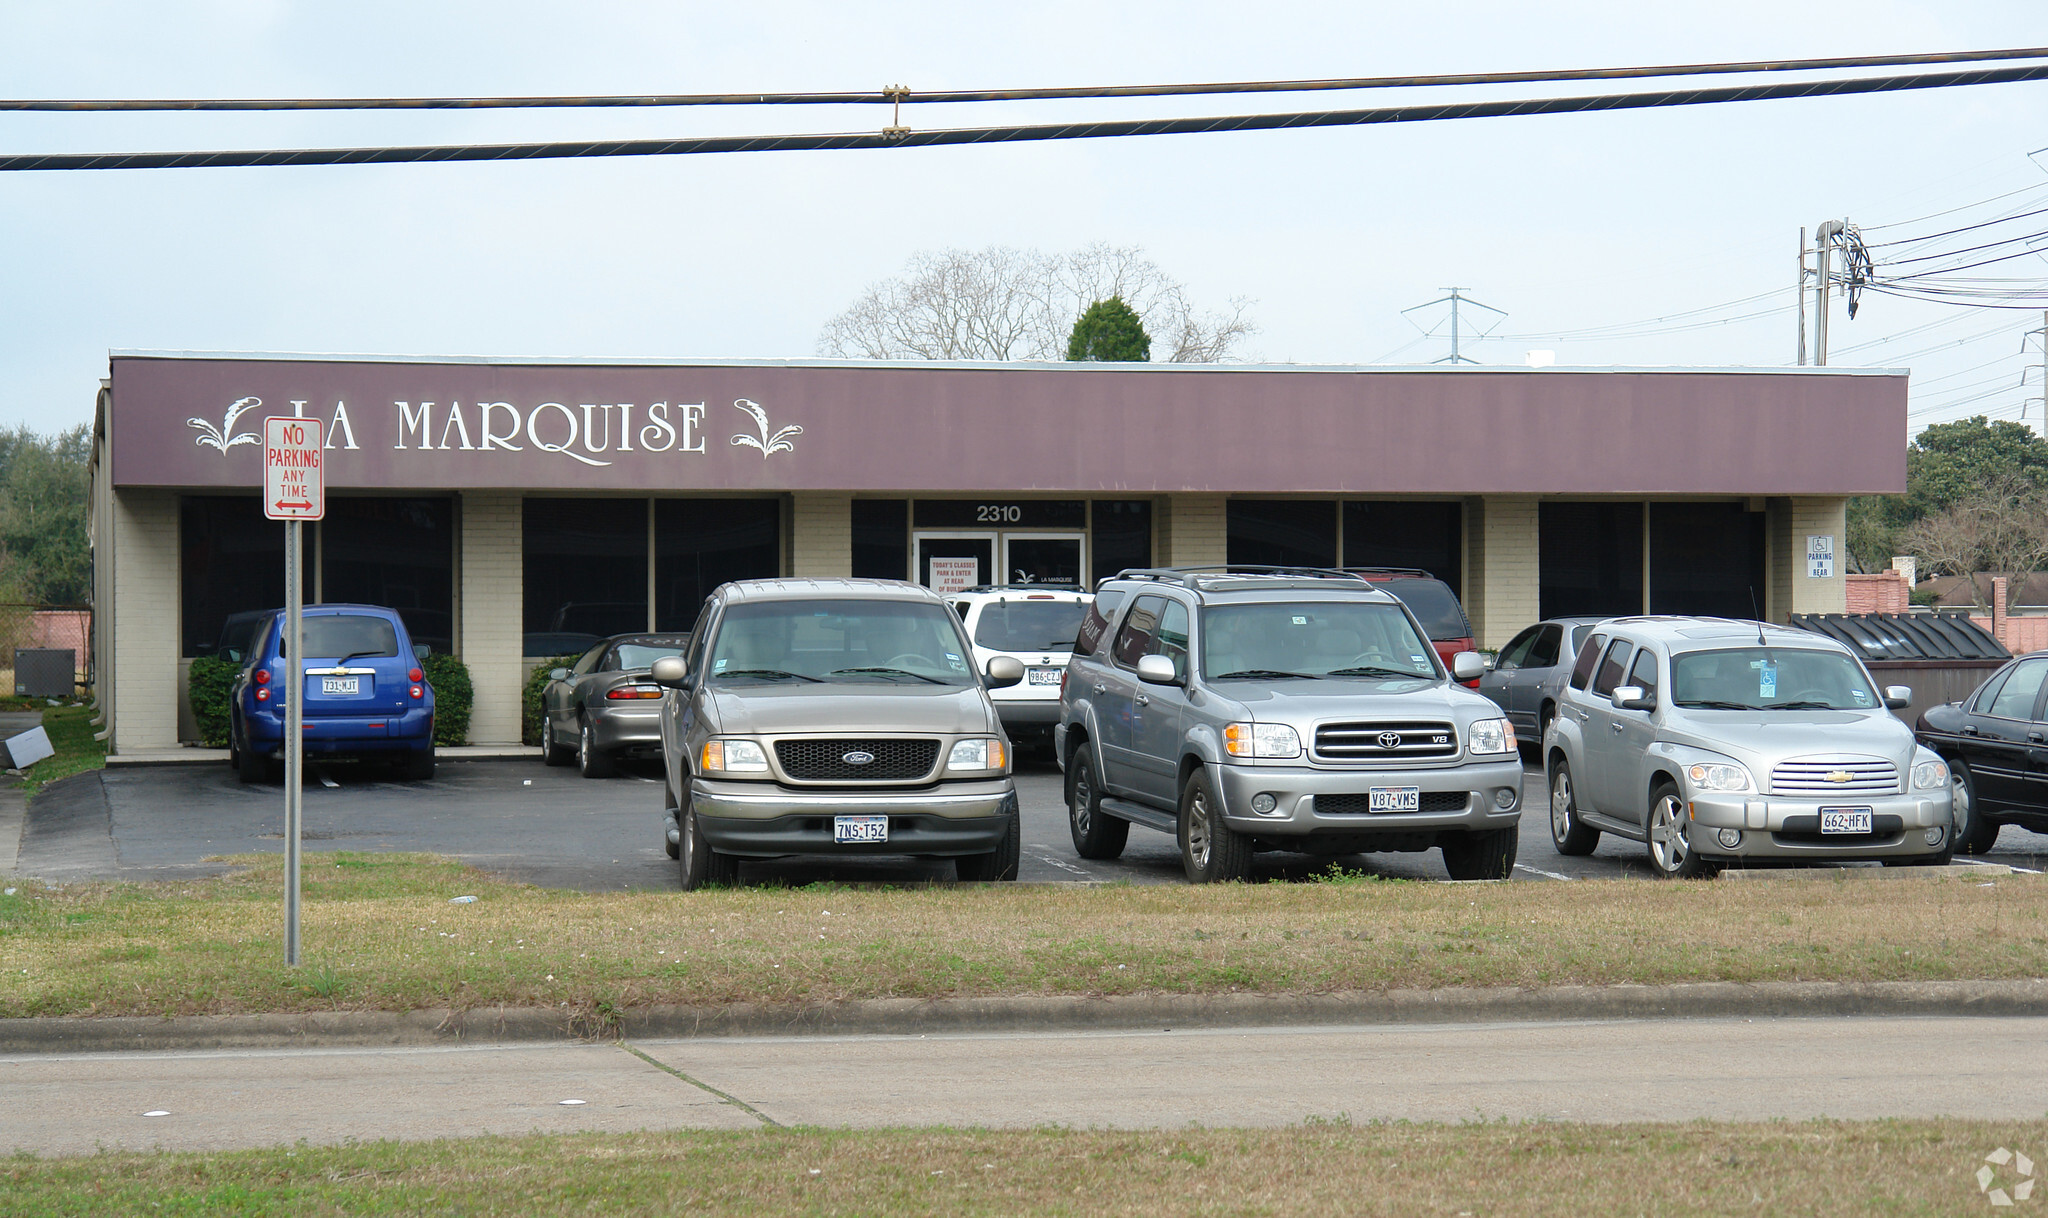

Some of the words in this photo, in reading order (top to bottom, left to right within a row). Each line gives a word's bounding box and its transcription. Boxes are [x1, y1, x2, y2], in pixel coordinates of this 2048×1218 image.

[283, 427, 304, 445] NO
[394, 400, 705, 466] MARQUISE
[269, 448, 319, 468] PARKING
[283, 470, 305, 482] ANY
[280, 484, 307, 498] TIME
[976, 505, 1021, 522] 2310
[1808, 552, 1832, 560] PARKING
